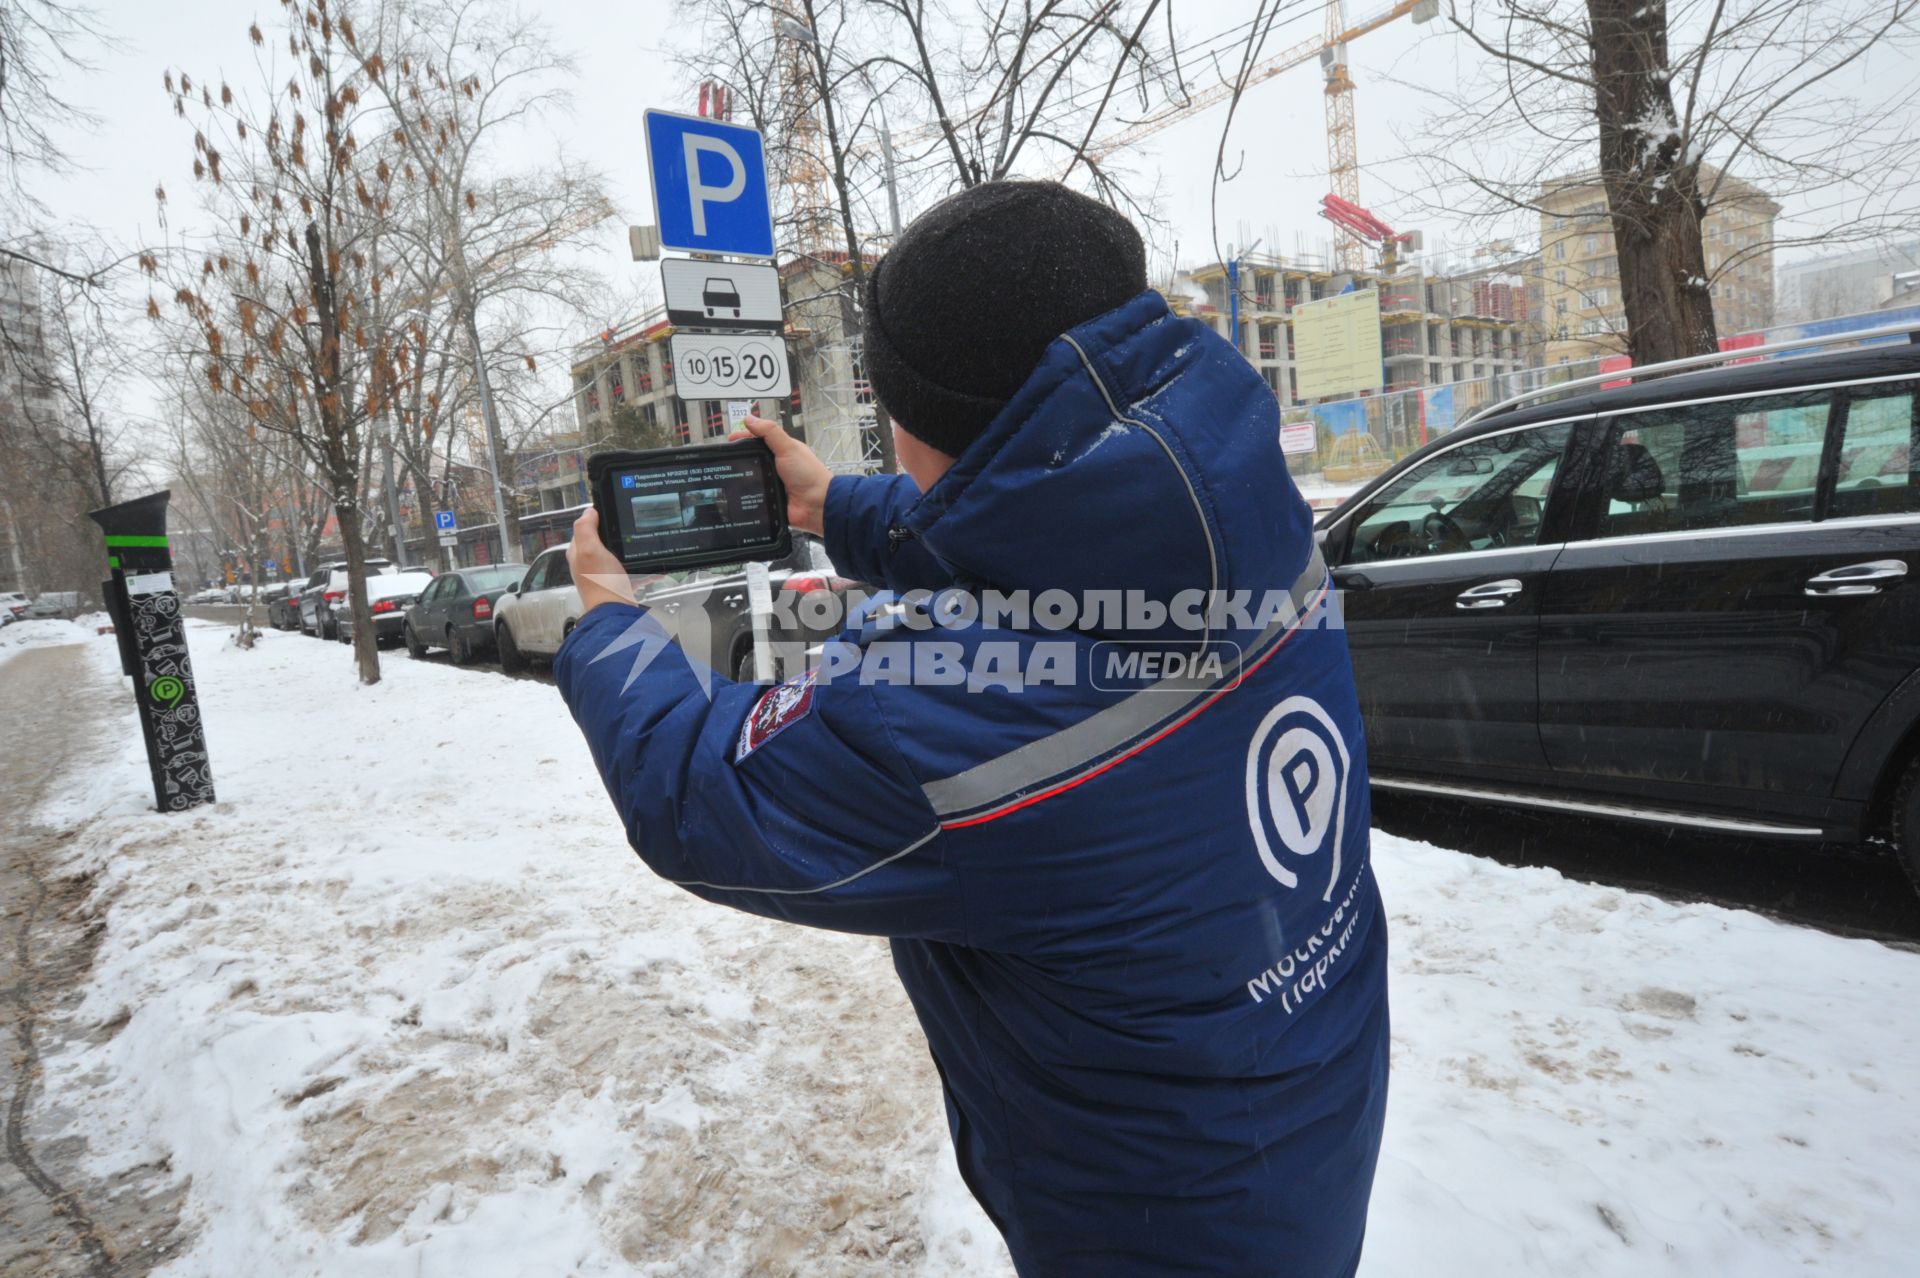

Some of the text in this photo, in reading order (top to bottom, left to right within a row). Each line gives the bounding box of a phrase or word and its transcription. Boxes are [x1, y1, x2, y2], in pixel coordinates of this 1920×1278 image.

[681, 132, 746, 237] P
[687, 354, 775, 380] 10 15 20
[440, 513, 451, 528] P
[162, 684, 174, 697] P
[1280, 747, 1320, 839] P
